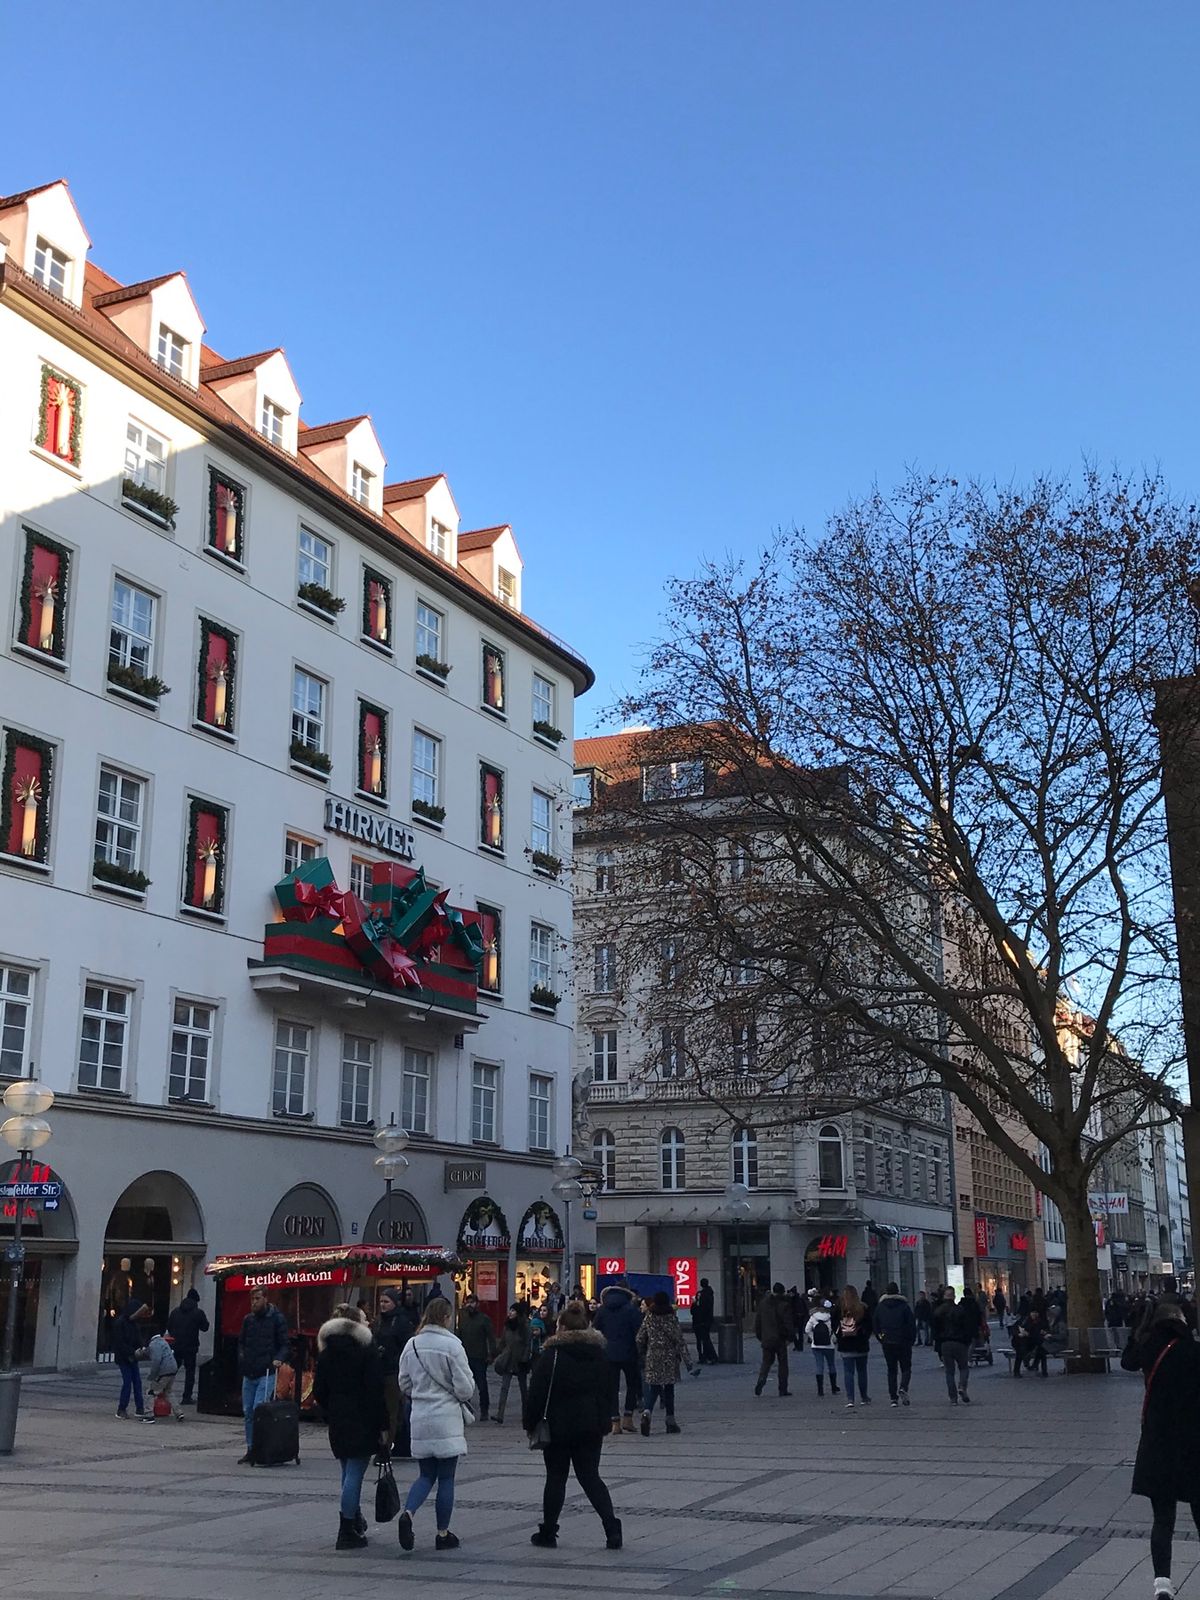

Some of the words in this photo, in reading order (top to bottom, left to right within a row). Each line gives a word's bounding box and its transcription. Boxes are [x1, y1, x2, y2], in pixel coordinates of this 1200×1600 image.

[328, 799, 416, 860] HIRMER
[244, 1273, 282, 1287] Heiße
[285, 1271, 332, 1284] Maroni
[676, 1260, 690, 1306] SALE
